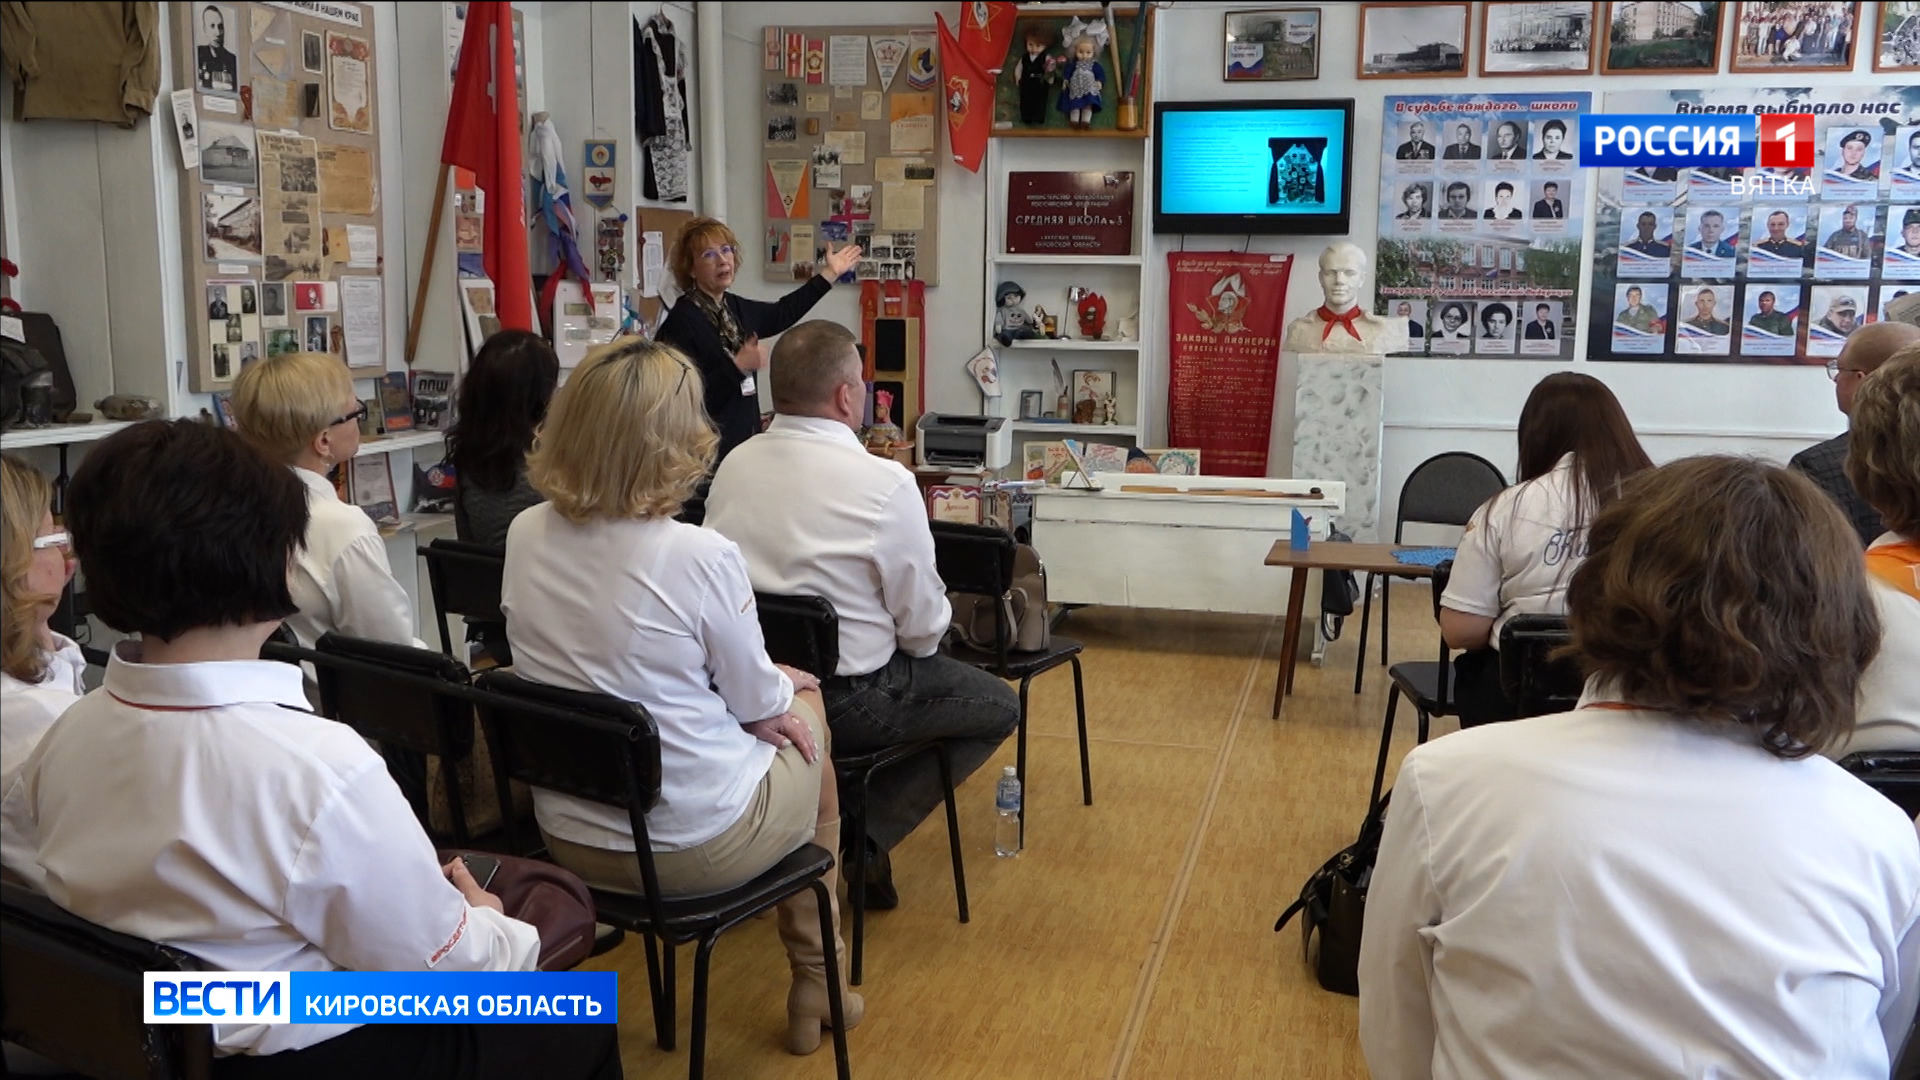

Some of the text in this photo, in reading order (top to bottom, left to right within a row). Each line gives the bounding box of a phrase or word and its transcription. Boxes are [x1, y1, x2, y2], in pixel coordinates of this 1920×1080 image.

[1676, 99, 1902, 115] Время выбрало нас
[1015, 214, 1064, 226] СРЕДНЯЯ
[1068, 214, 1107, 226] ШКОЛА
[1175, 333, 1277, 346] ЗАКОНЫ ПИОНЕРОВ
